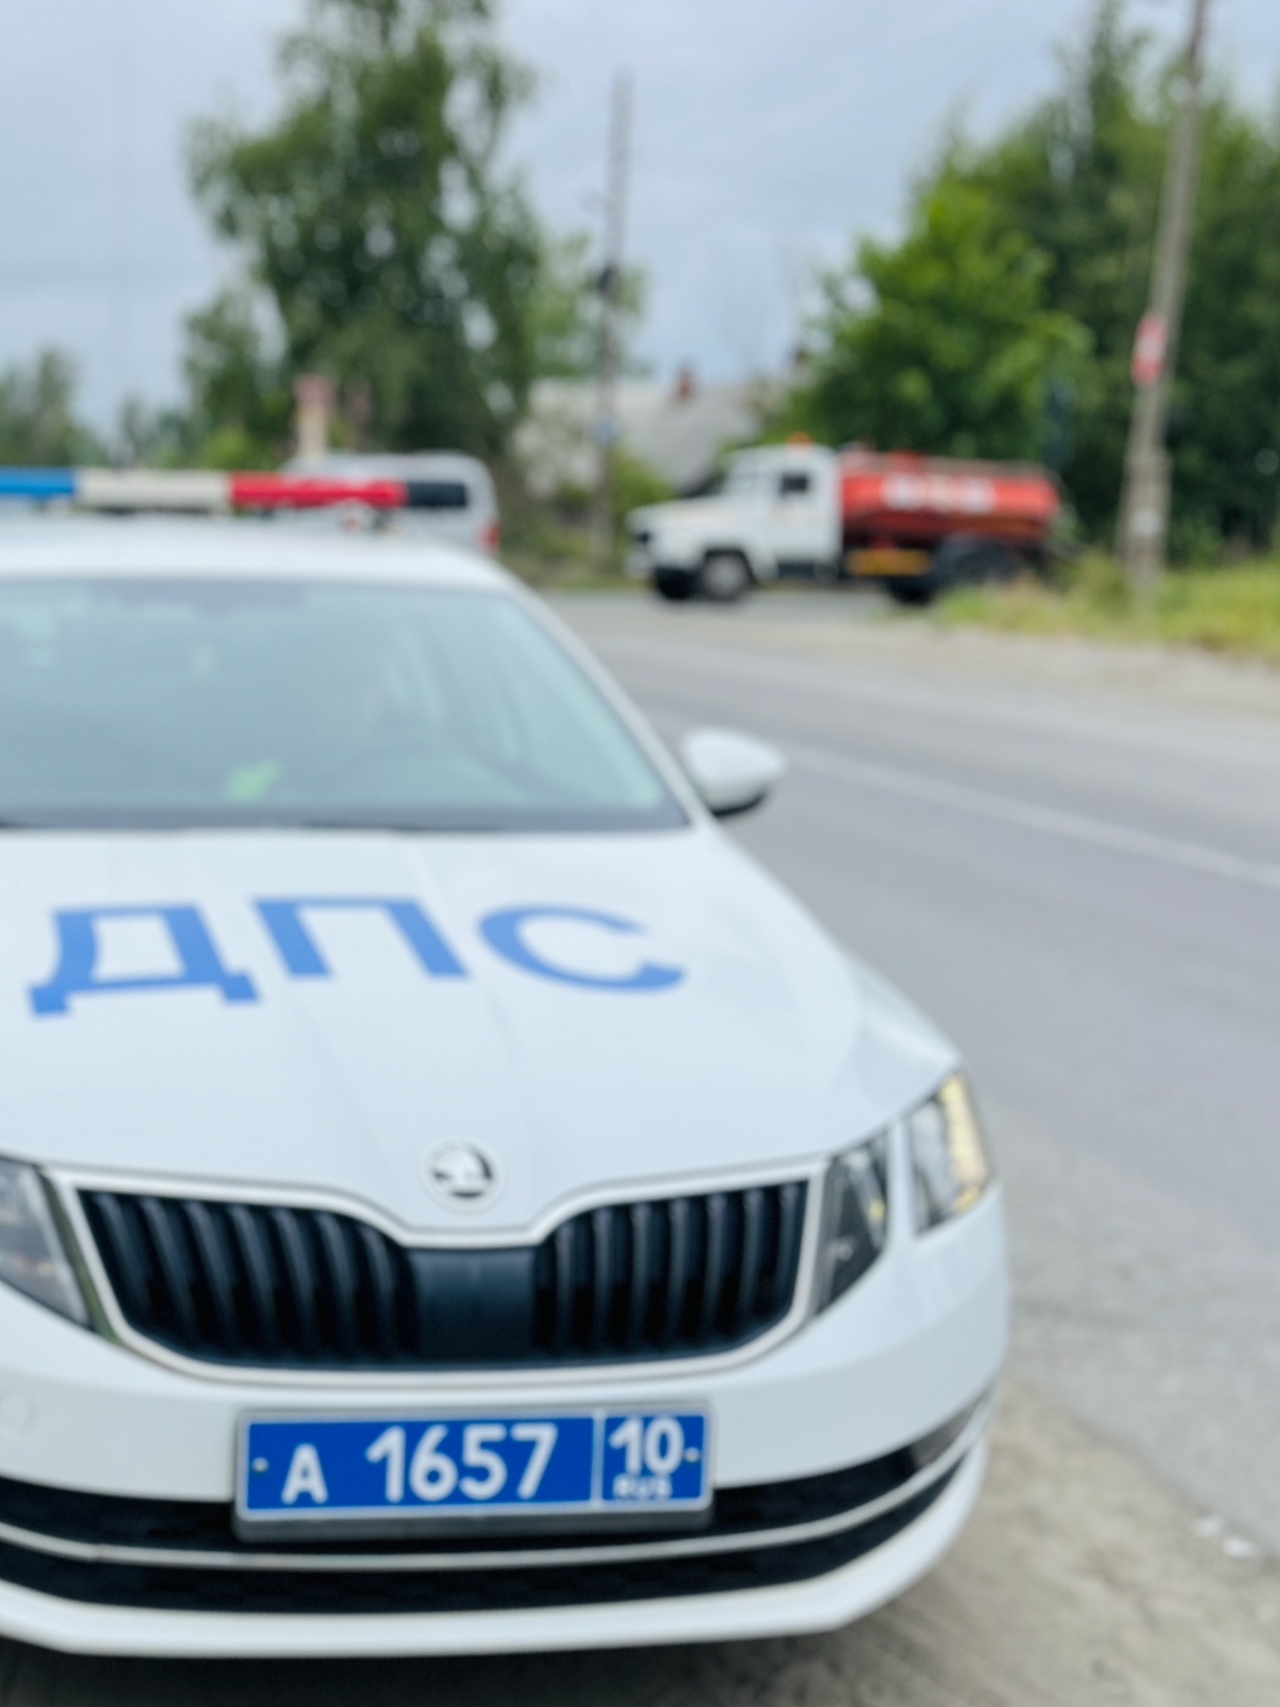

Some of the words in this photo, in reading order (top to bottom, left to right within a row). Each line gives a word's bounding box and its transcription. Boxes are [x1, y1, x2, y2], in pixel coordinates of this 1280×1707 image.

[27, 896, 687, 1017] ДПС
[366, 1423, 558, 1502] 1657
[608, 1417, 684, 1475] 10
